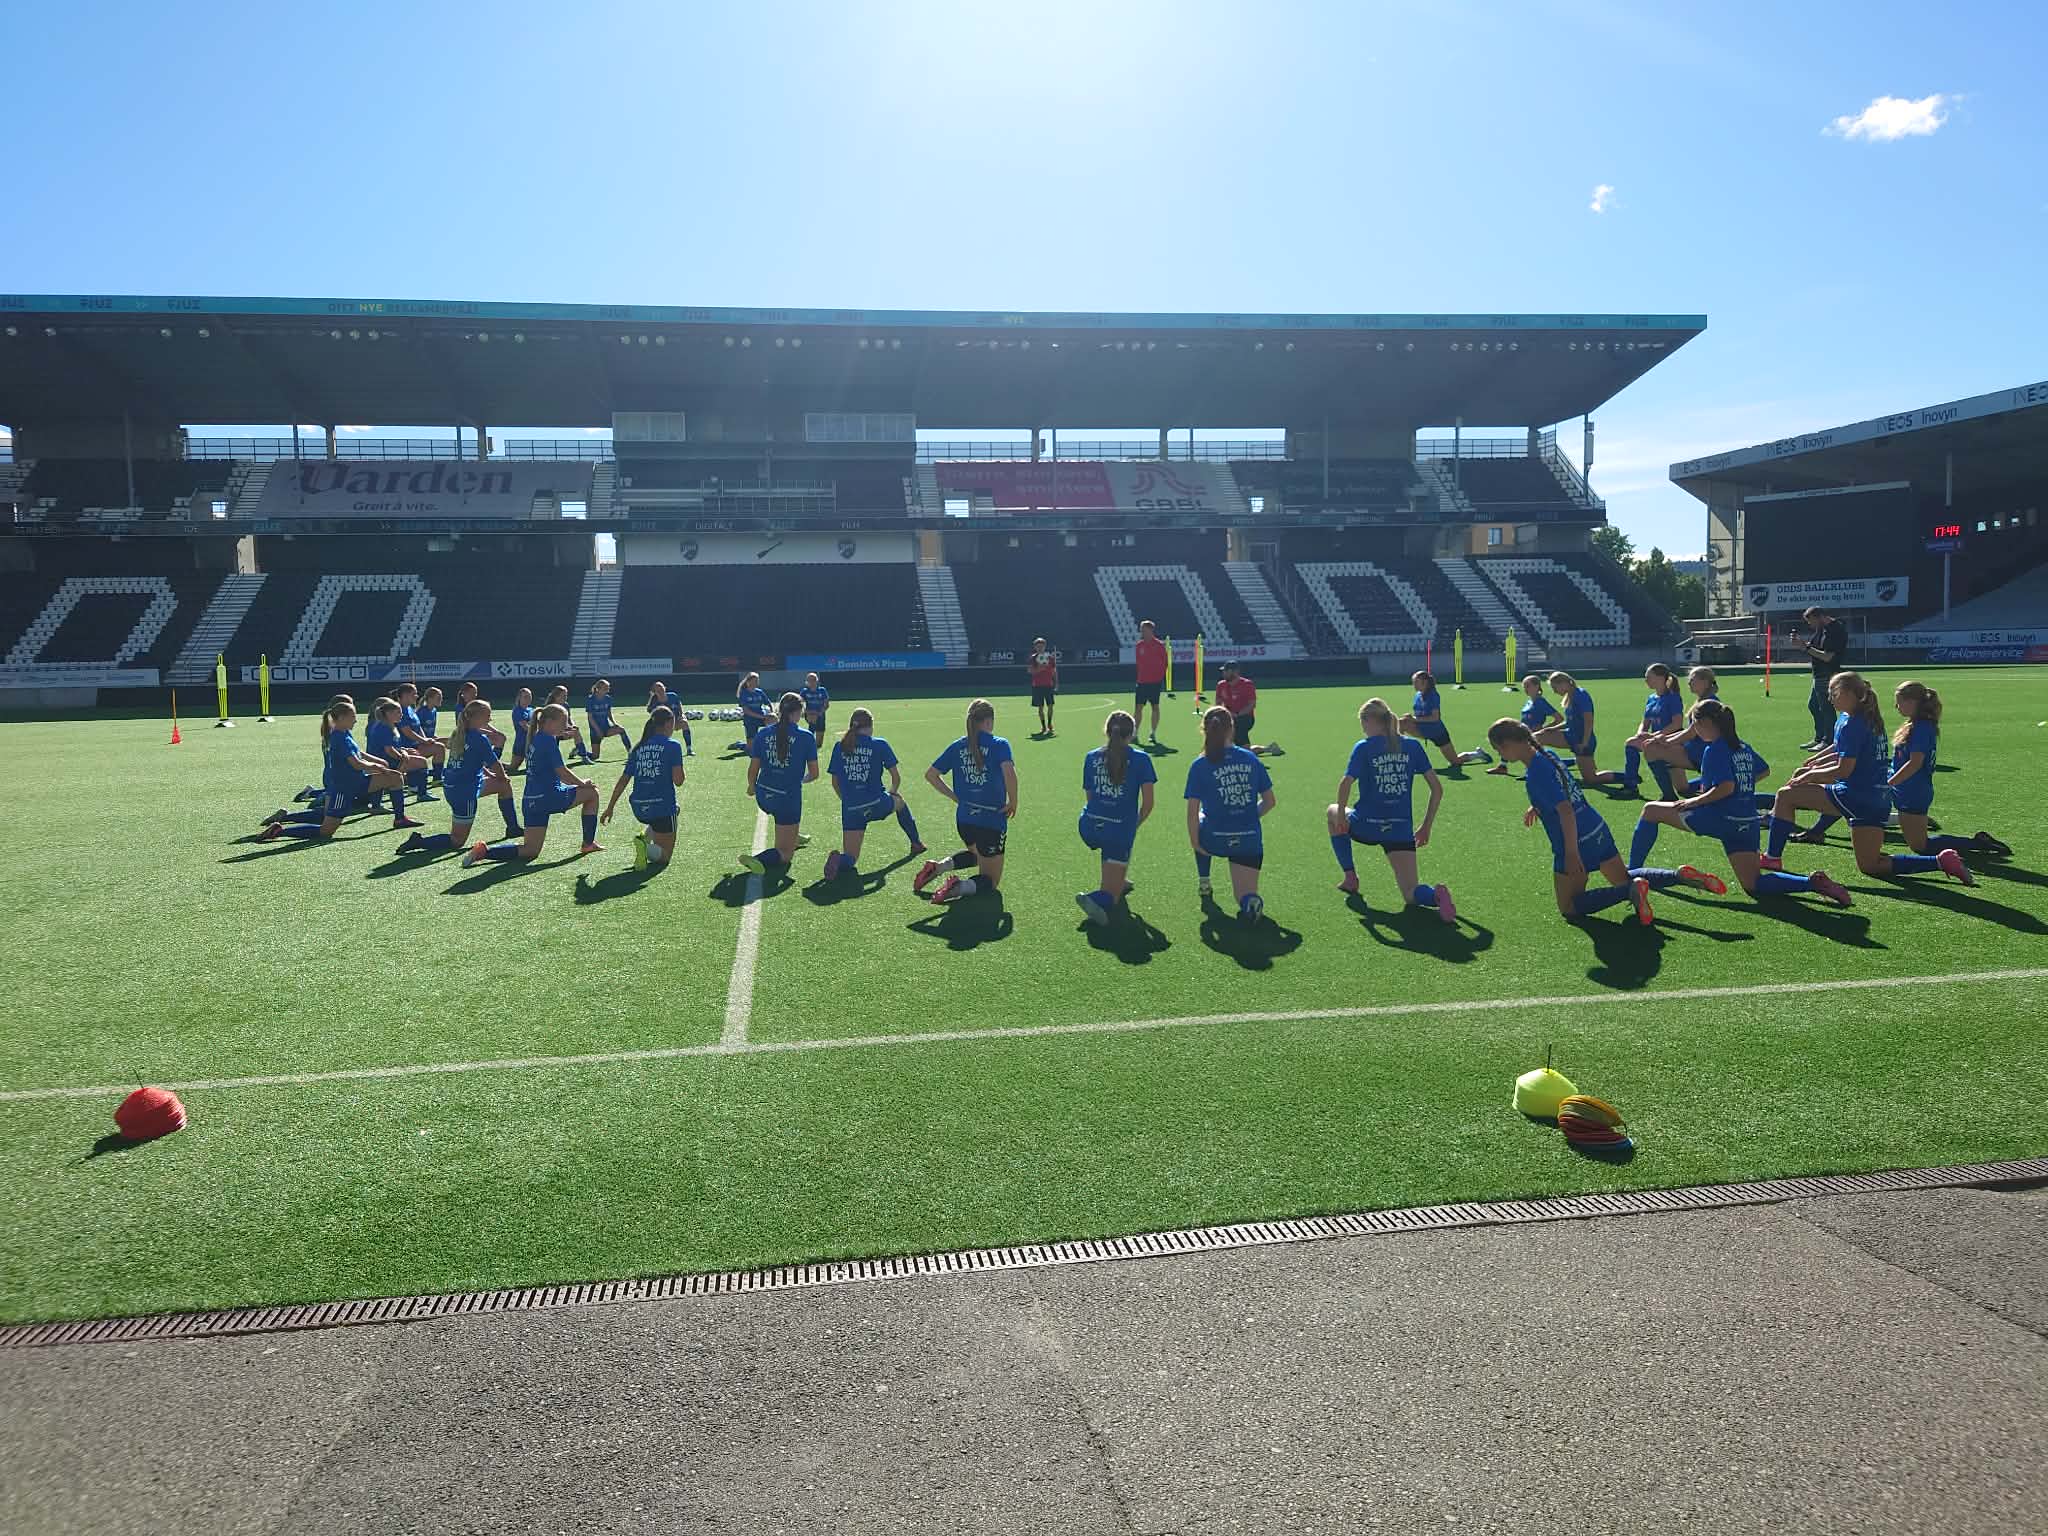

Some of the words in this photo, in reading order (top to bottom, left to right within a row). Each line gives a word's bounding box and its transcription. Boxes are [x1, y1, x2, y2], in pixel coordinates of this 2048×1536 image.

[359, 303, 384, 313] NYE
[1876, 414, 1913, 433] INEOS
[1921, 407, 1958, 424] Inovyn
[1935, 525, 1960, 537] 17:44
[513, 662, 567, 677] Trosvik
[1372, 752, 1409, 768] SAMMEN
[1213, 763, 1252, 780] SAMMEN
[1374, 773, 1398, 785] TING
